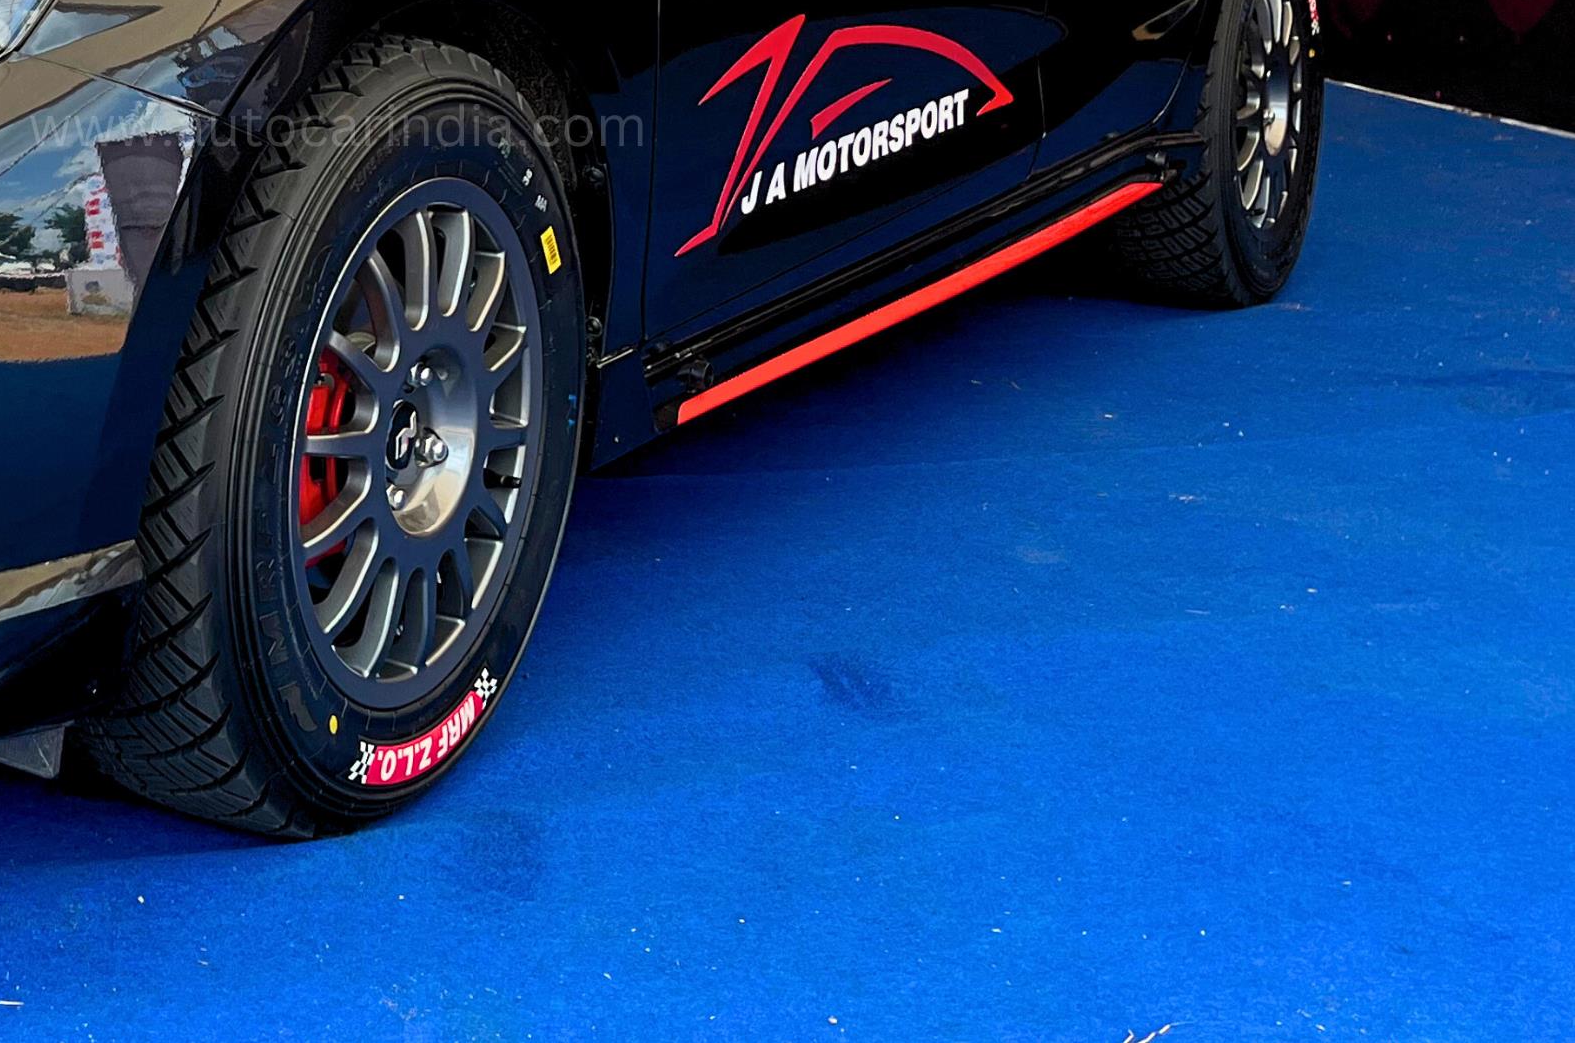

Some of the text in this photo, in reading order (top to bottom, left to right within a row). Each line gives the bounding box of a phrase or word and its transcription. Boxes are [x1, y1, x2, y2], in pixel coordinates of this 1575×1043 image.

[741, 88, 969, 214] J A MOTORSPORT
[437, 696, 476, 759] MRF
